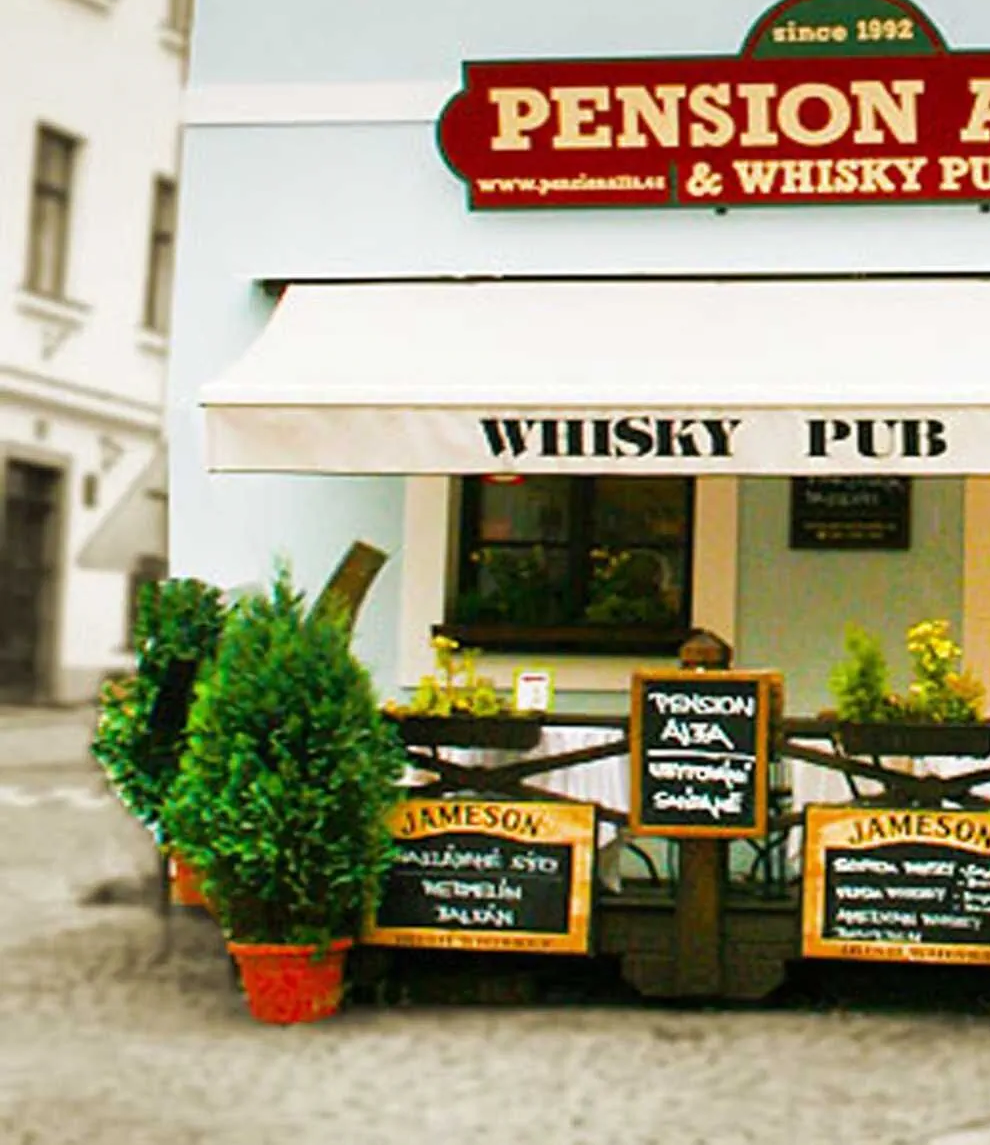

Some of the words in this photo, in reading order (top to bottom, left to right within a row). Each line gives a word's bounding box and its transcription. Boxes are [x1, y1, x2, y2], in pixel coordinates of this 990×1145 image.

[773, 20, 847, 43] since
[857, 19, 914, 41] 1992
[488, 78, 925, 151] PENSION
[685, 161, 724, 197] &
[732, 156, 928, 195] WHISKY
[480, 415, 742, 460] WHISKY
[806, 417, 949, 460] PUB
[648, 691, 755, 718] PENSION
[401, 804, 545, 837] JAMESON
